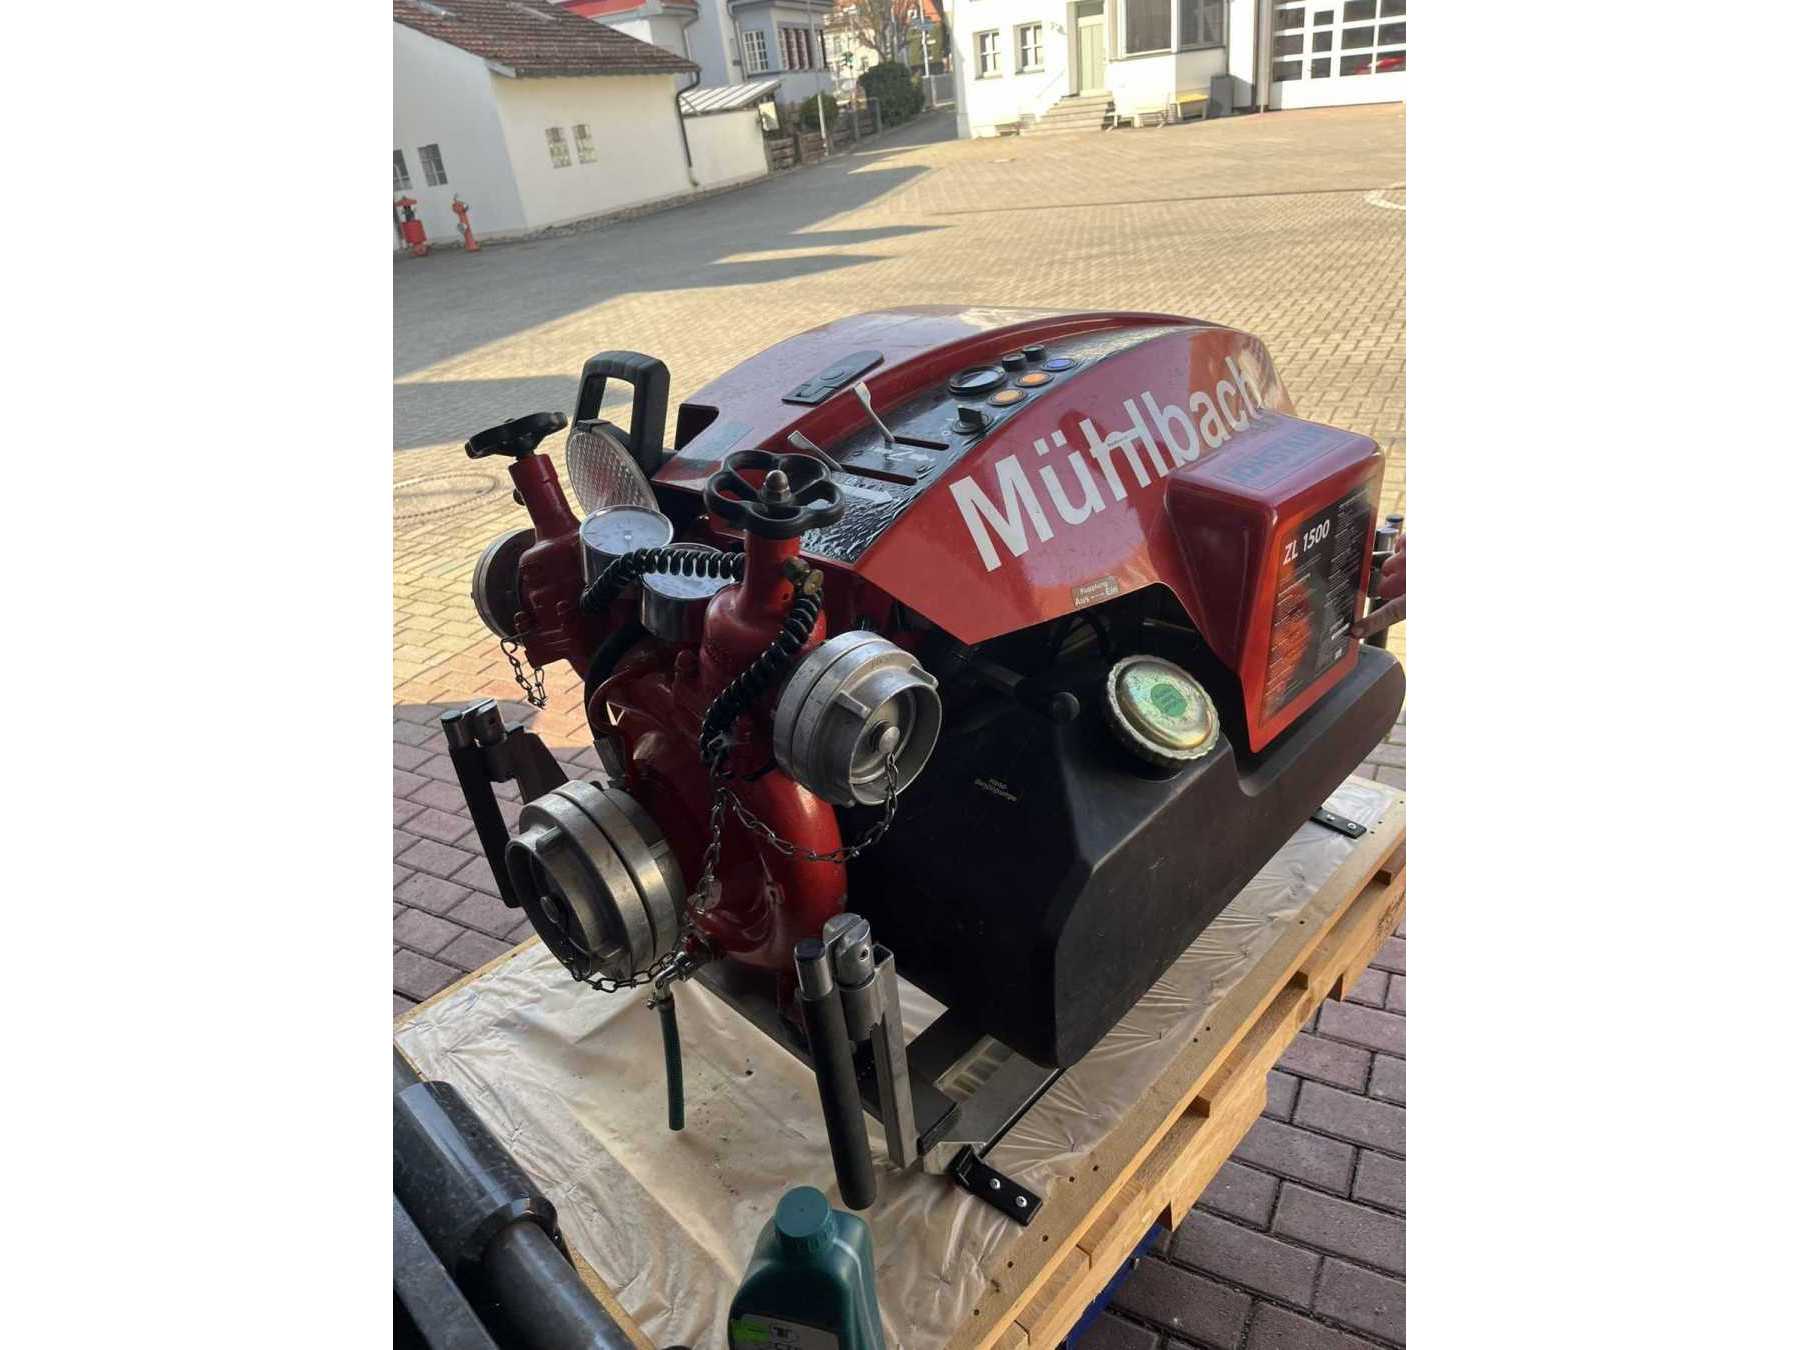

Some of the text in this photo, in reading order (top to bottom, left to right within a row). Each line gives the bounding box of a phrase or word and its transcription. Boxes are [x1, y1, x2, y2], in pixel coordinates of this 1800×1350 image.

[949, 355, 1262, 572] Mühlbach
[1283, 540, 1299, 565] ZL
[1303, 519, 1330, 552] 1500
